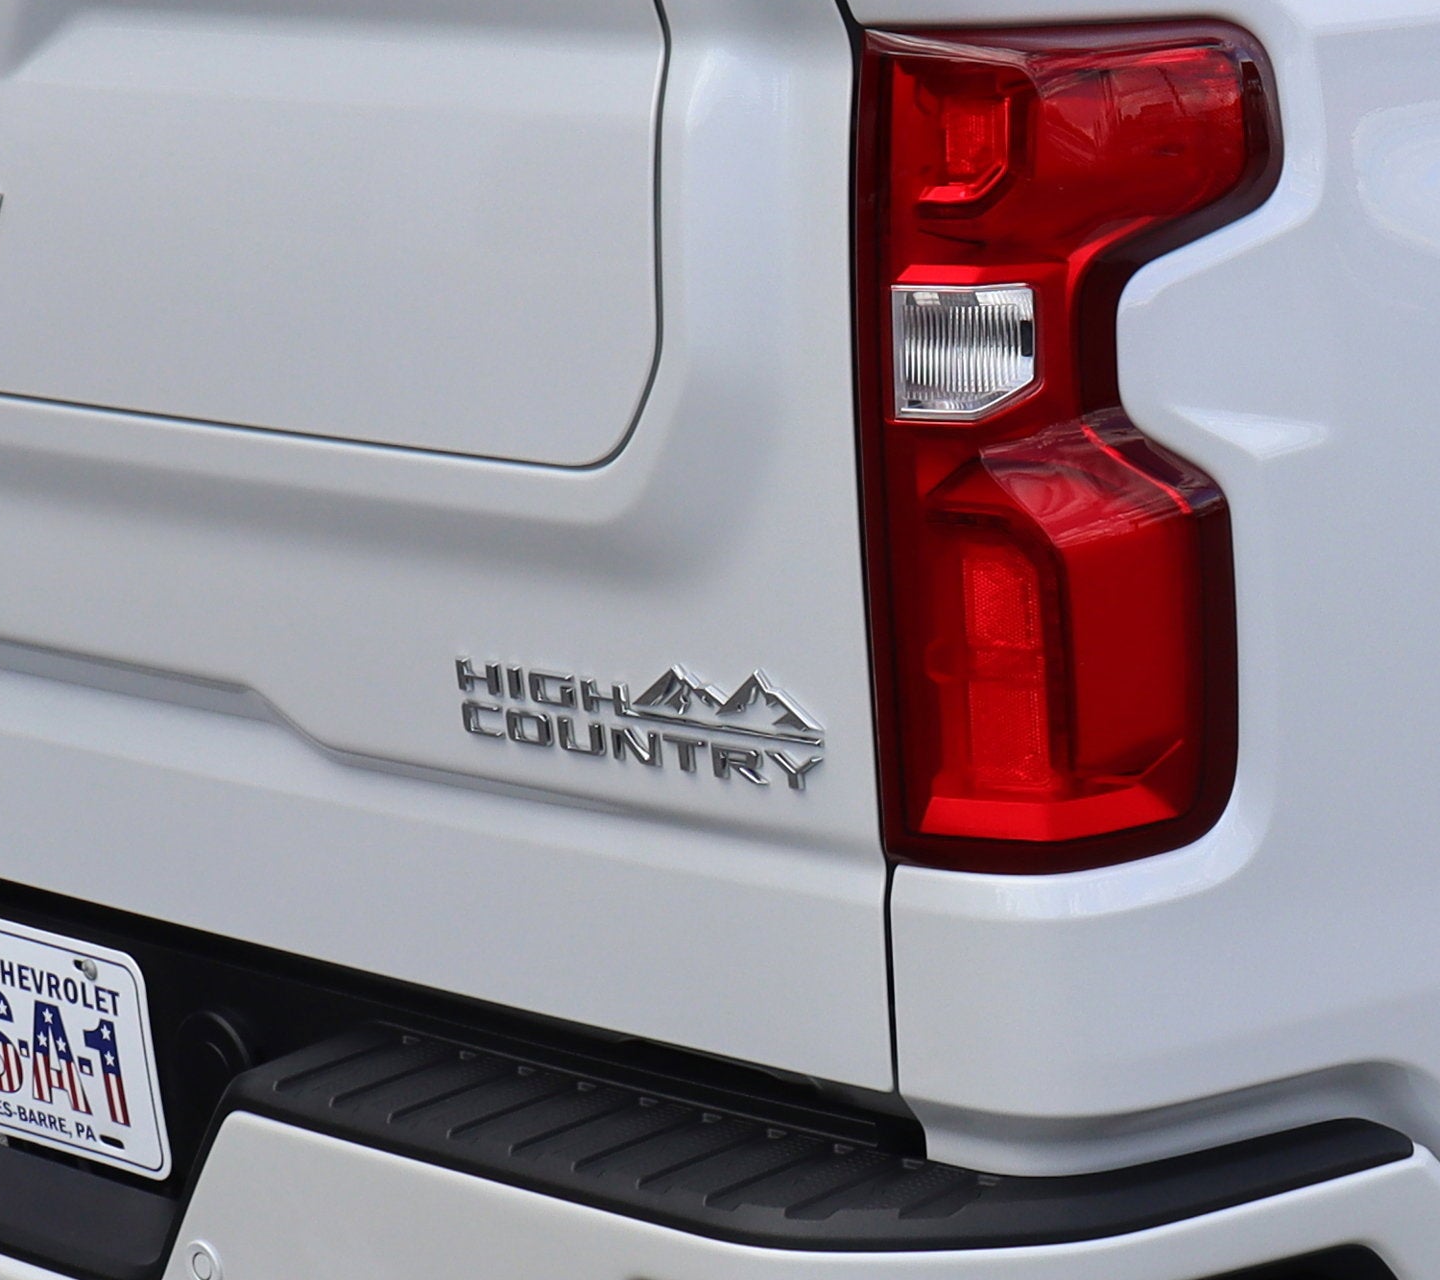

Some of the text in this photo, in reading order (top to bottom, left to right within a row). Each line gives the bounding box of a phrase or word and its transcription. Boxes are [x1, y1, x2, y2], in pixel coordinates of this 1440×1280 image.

[454, 655, 631, 718] HIGH
[461, 699, 824, 791] COUNTRY
[75, 1122, 98, 1142] PA
